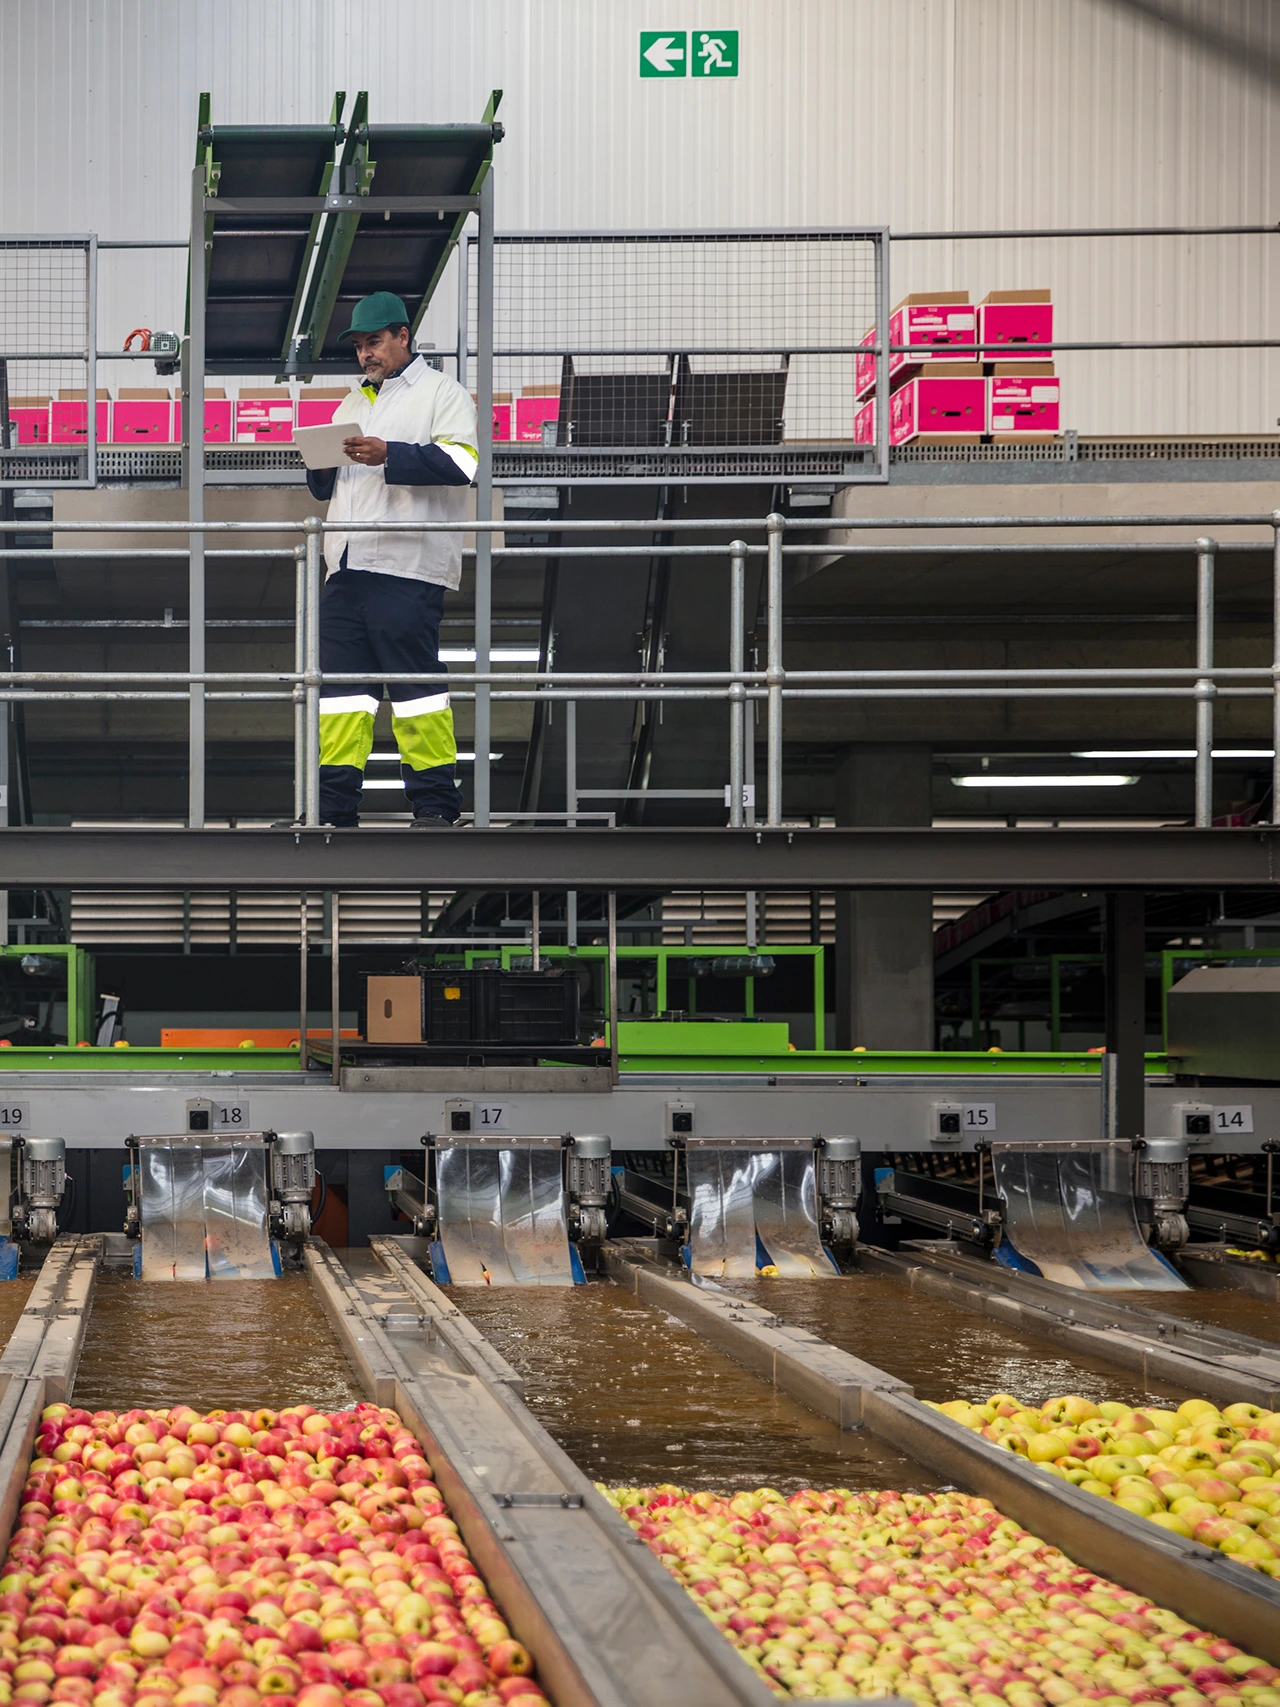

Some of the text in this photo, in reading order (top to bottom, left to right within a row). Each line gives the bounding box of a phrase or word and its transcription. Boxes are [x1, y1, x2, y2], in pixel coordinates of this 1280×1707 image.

[1, 1108, 23, 1124] 19
[220, 1107, 242, 1124] 18
[481, 1108, 503, 1124] 17
[966, 1109, 989, 1126] 15
[1217, 1111, 1245, 1128] 14
